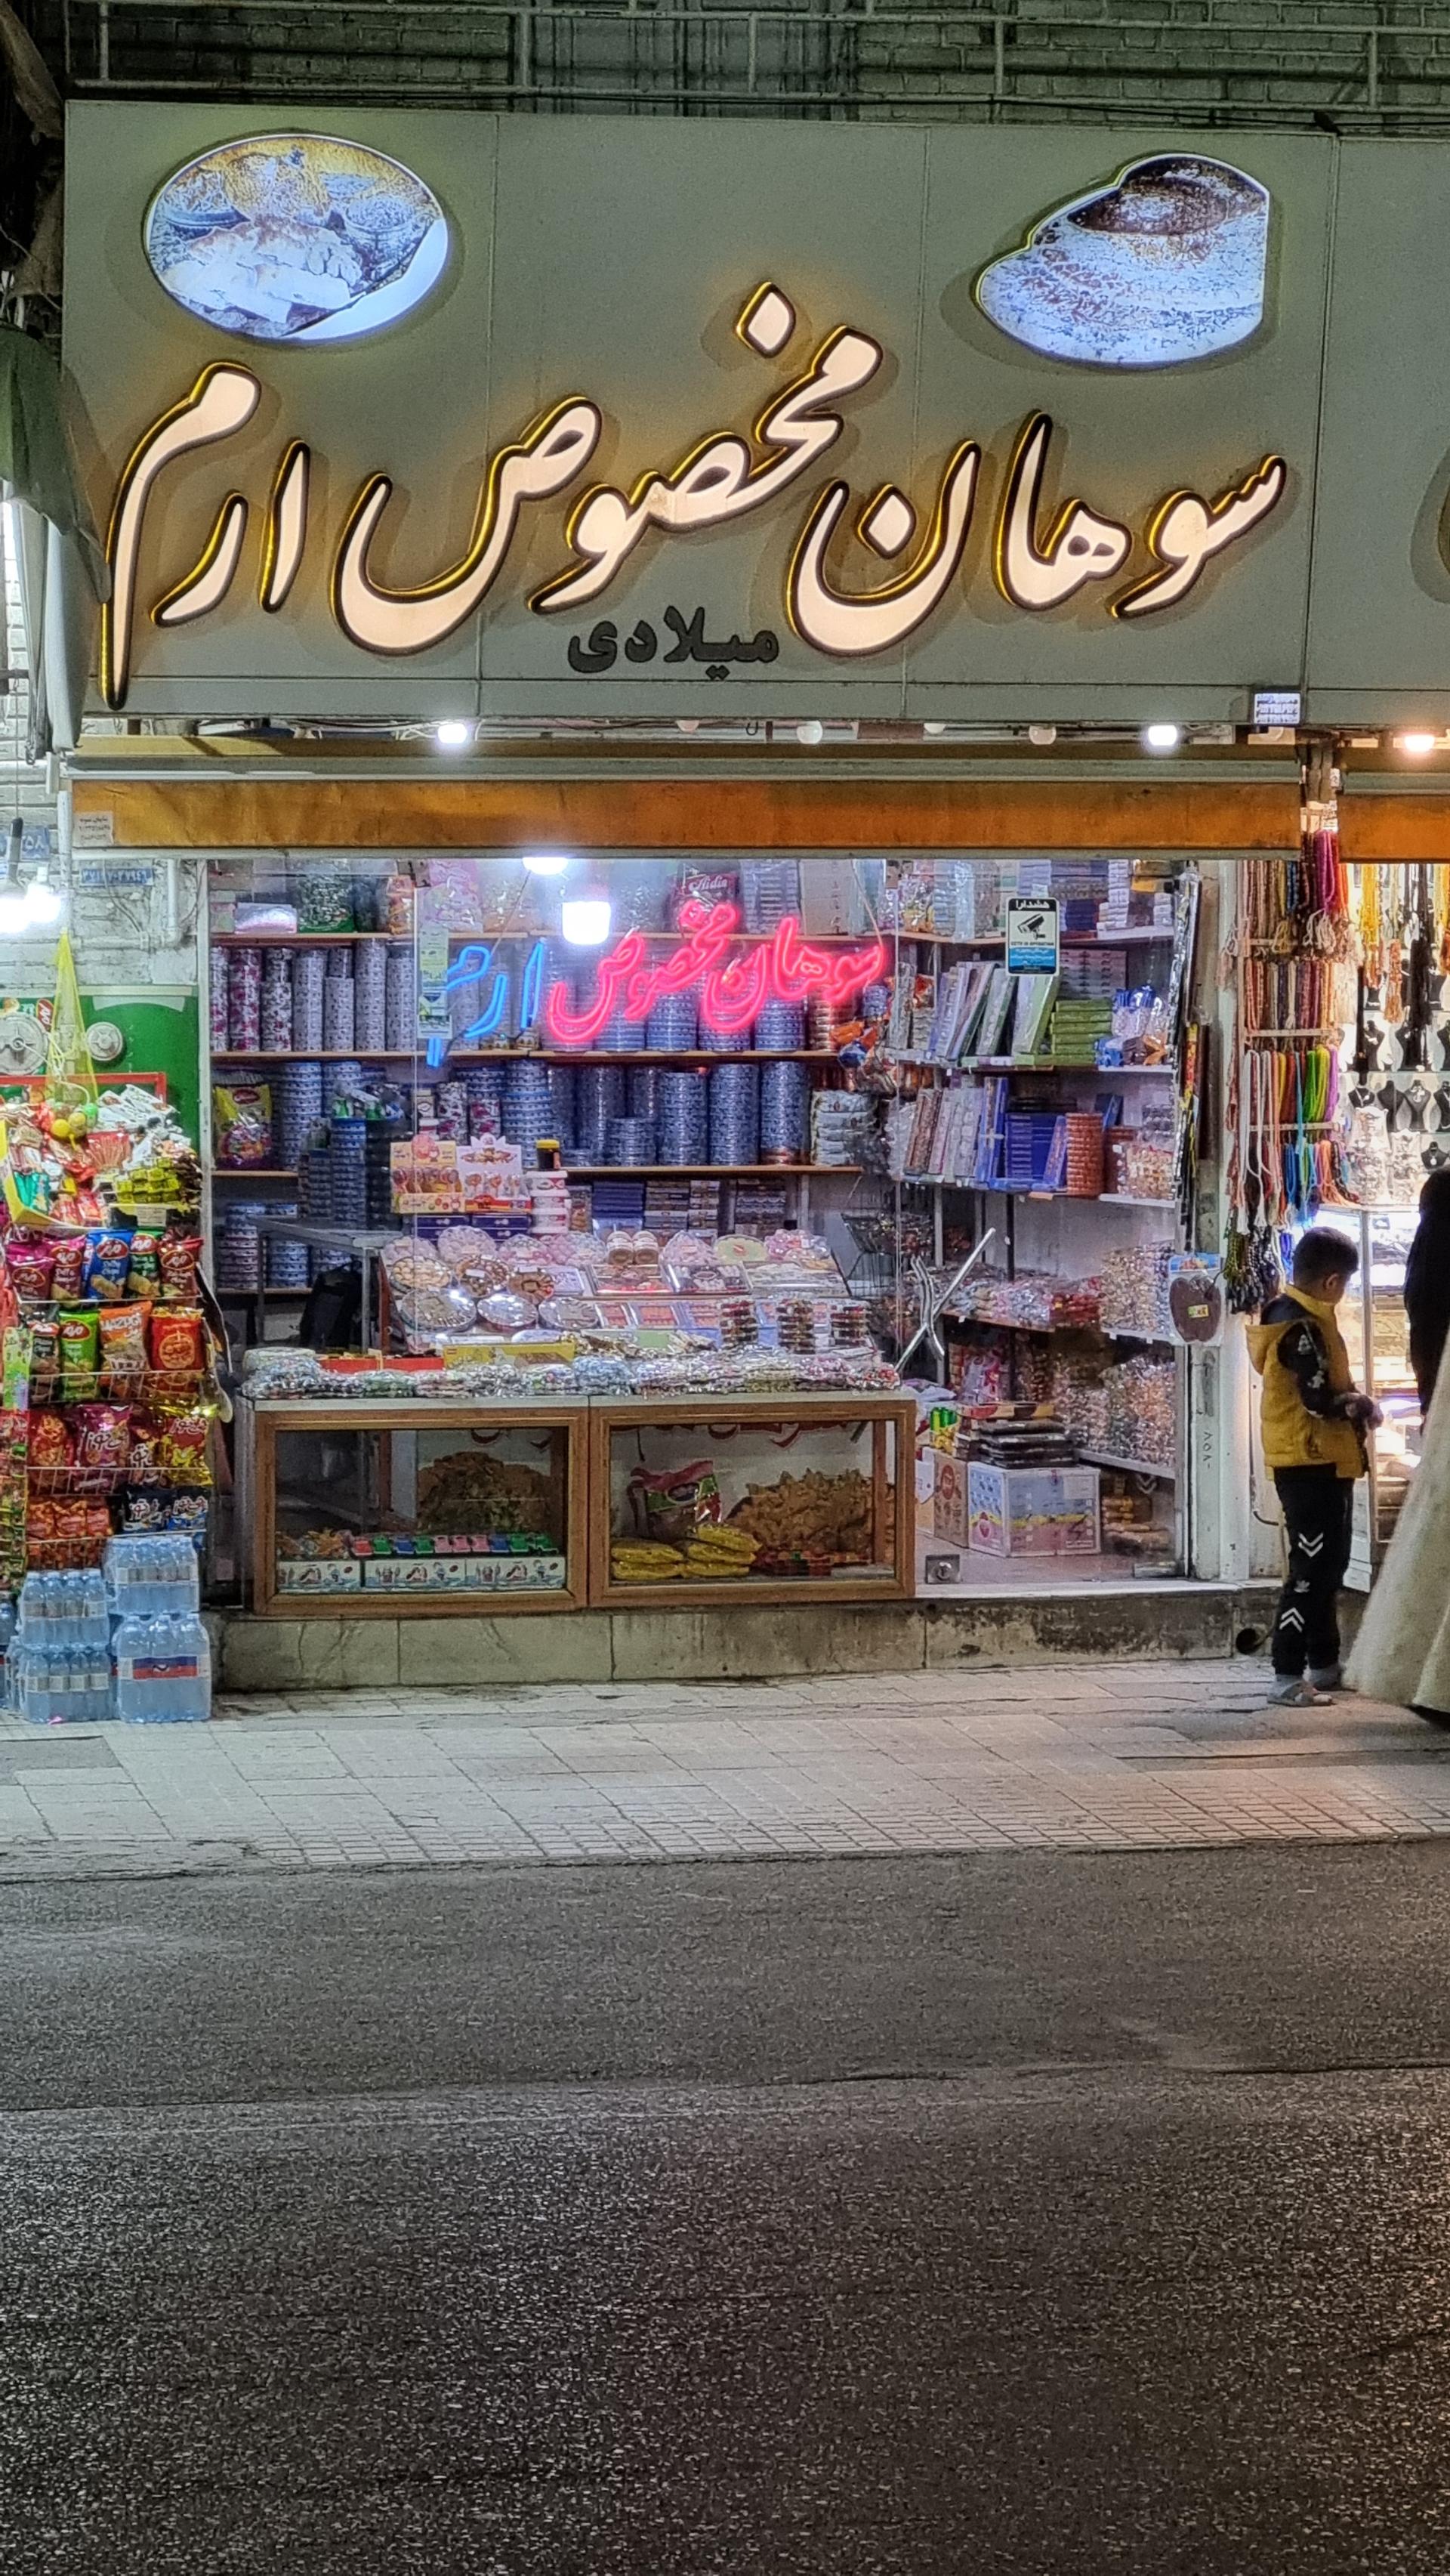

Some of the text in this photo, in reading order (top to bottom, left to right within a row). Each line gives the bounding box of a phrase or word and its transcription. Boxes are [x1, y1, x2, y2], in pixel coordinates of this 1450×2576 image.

[101, 281, 1287, 711] سوهان مخصوص ارم
[568, 604, 779, 680] میلادی
[548, 900, 739, 1044] مخصوص
[702, 916, 886, 1030] سوهان
